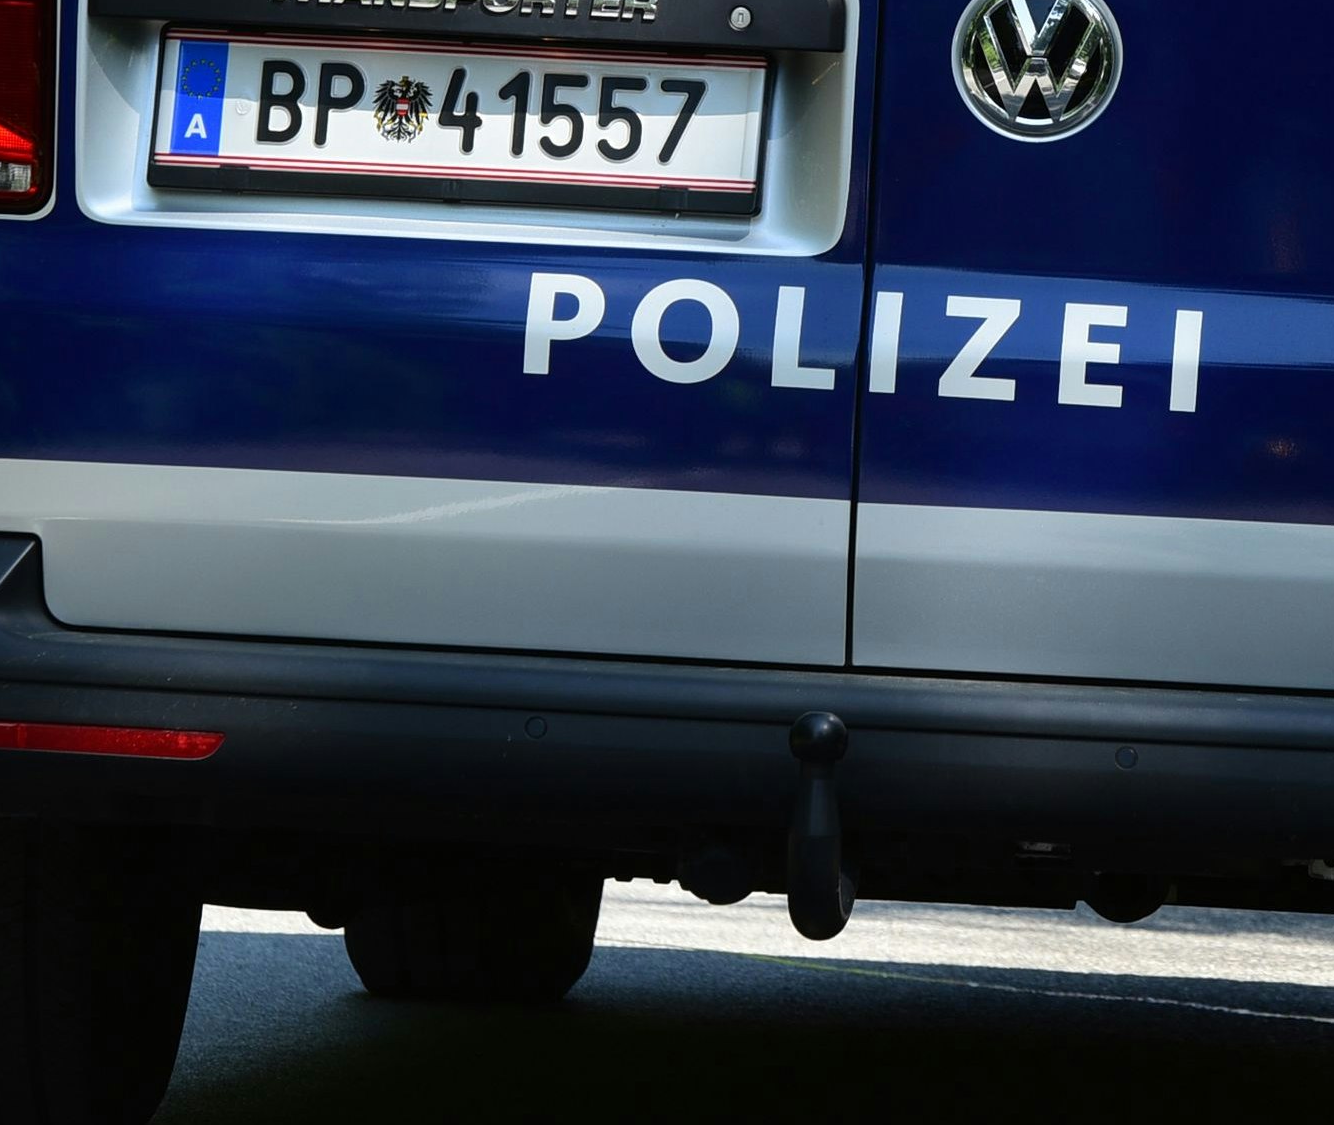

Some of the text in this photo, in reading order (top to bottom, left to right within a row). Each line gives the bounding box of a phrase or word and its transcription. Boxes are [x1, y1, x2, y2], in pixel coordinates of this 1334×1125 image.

[183, 59, 707, 165] A BP 41557
[522, 271, 1204, 413] POLIZEI
